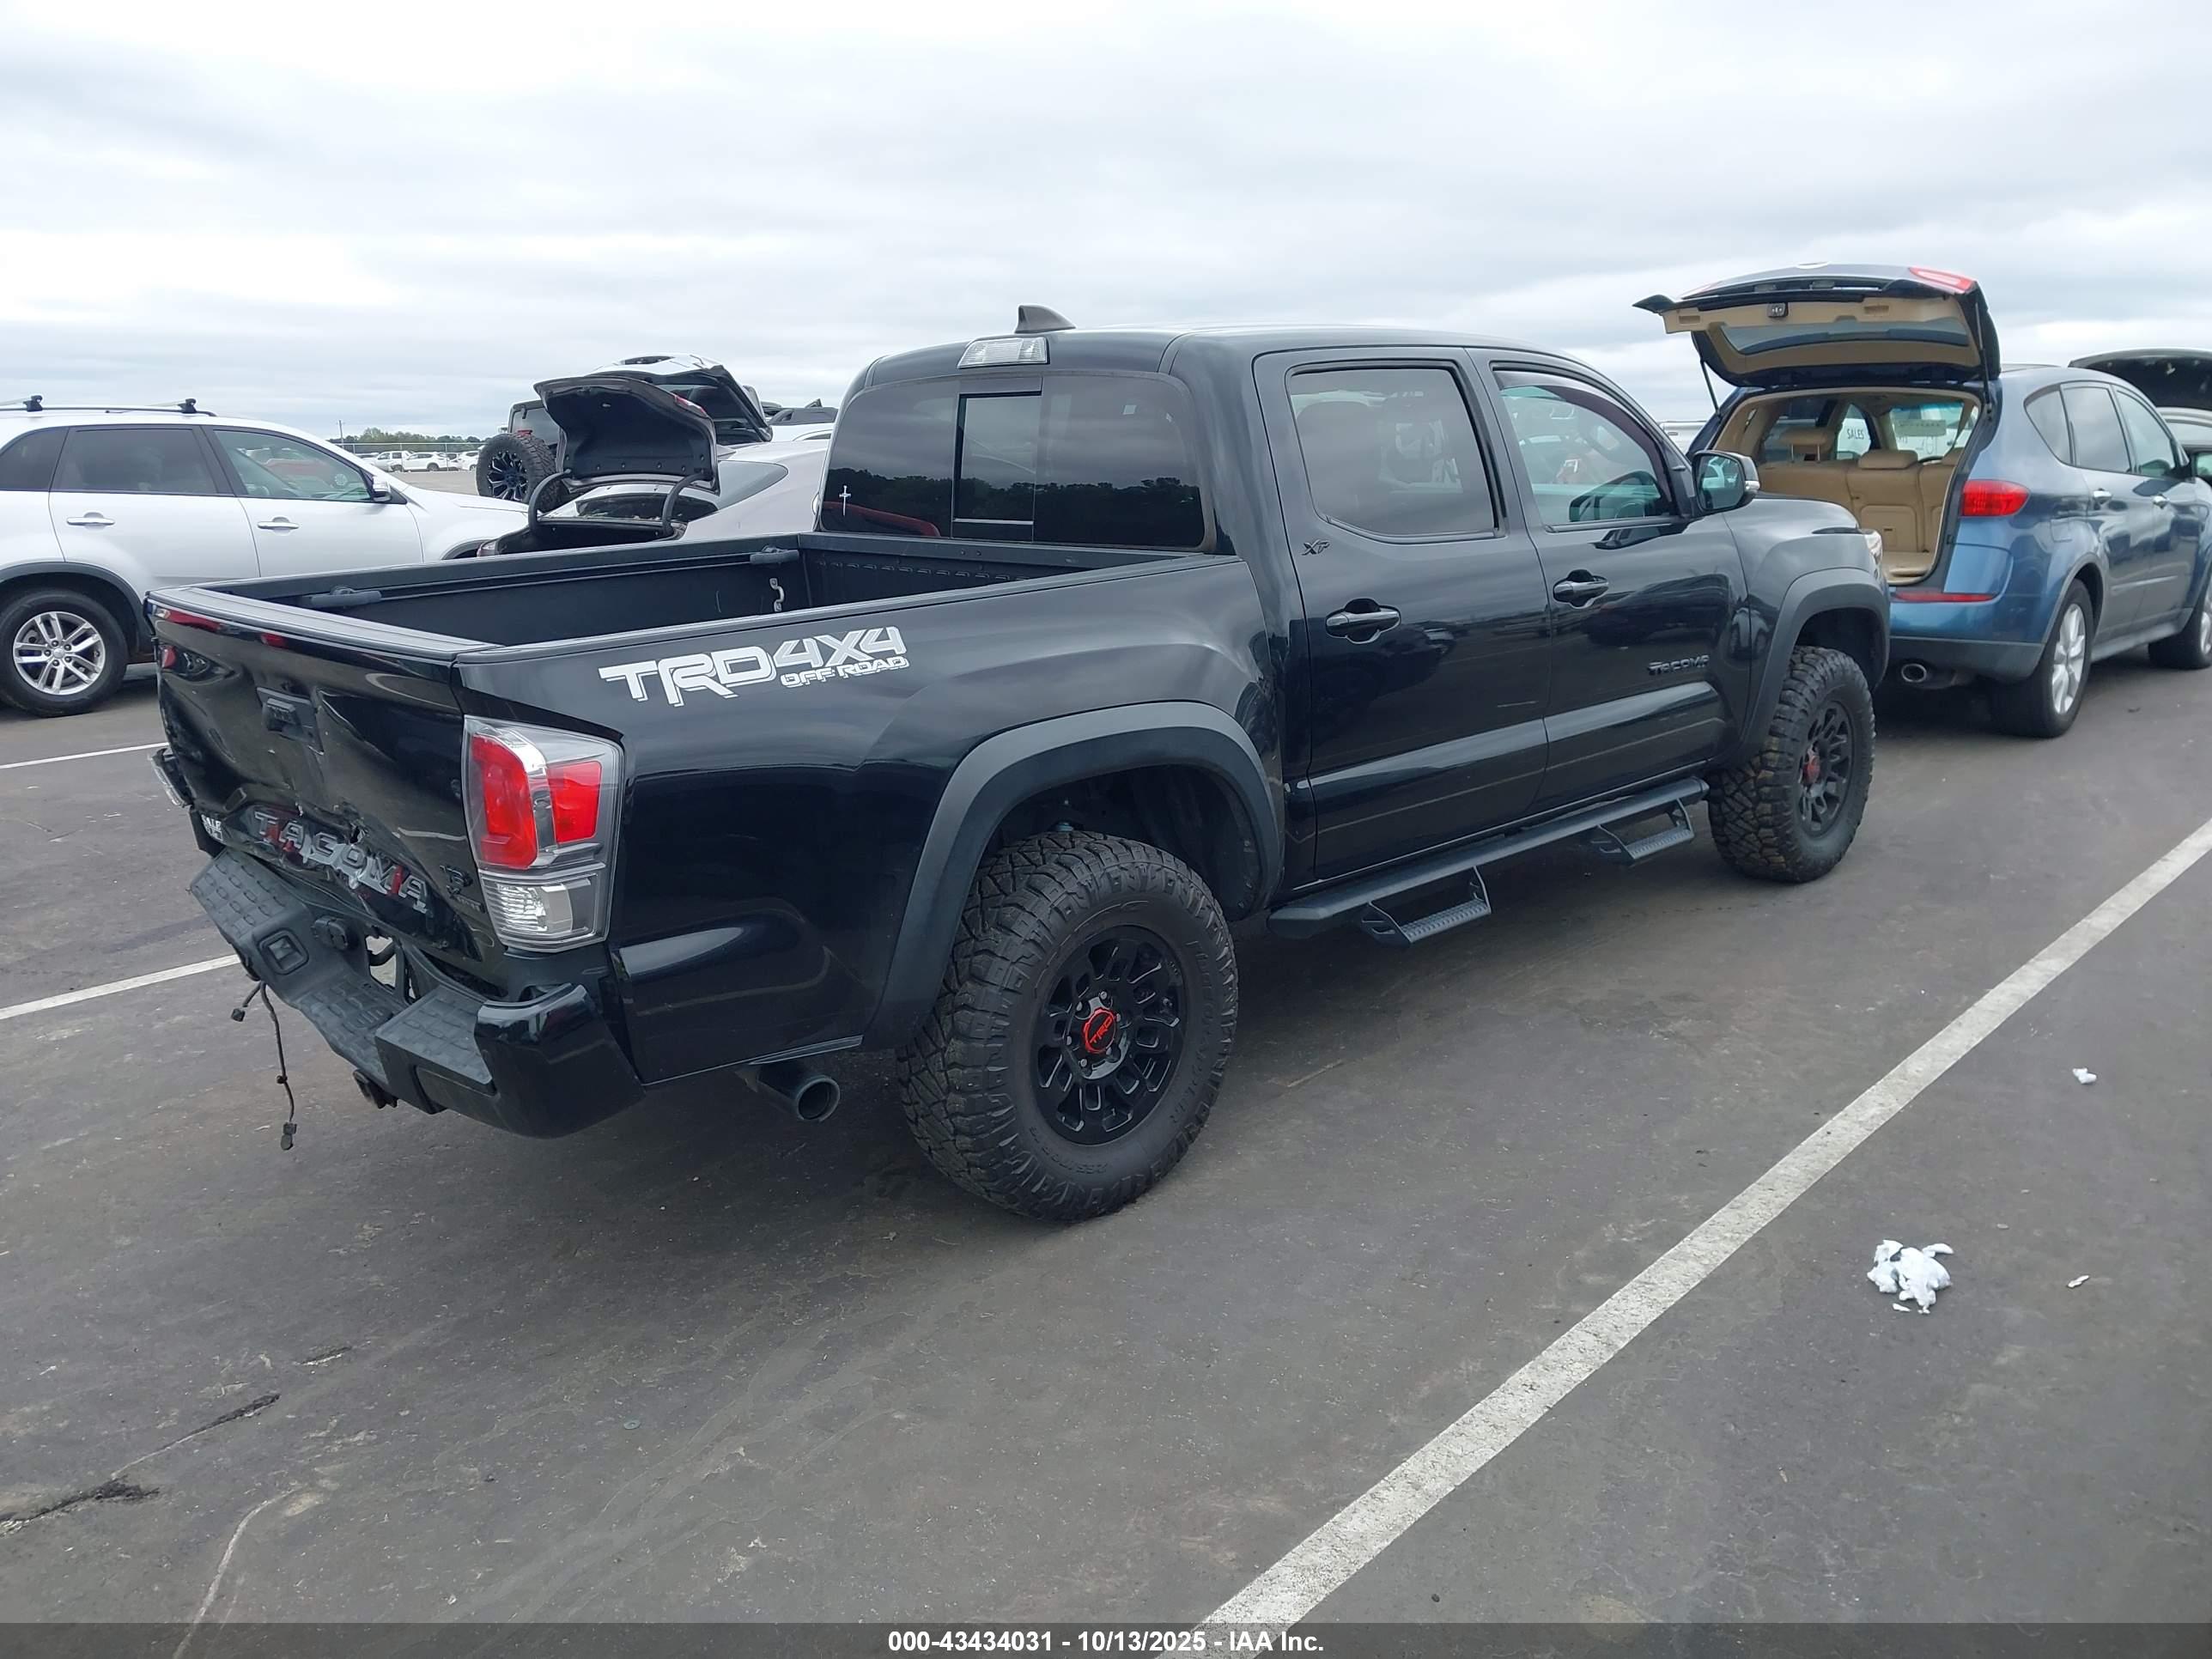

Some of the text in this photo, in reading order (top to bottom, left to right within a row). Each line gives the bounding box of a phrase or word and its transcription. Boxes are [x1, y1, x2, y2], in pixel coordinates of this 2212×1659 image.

[598, 646, 776, 707] TRD
[780, 655, 910, 689] OFF ROAD
[254, 810, 429, 915] TACOMA
